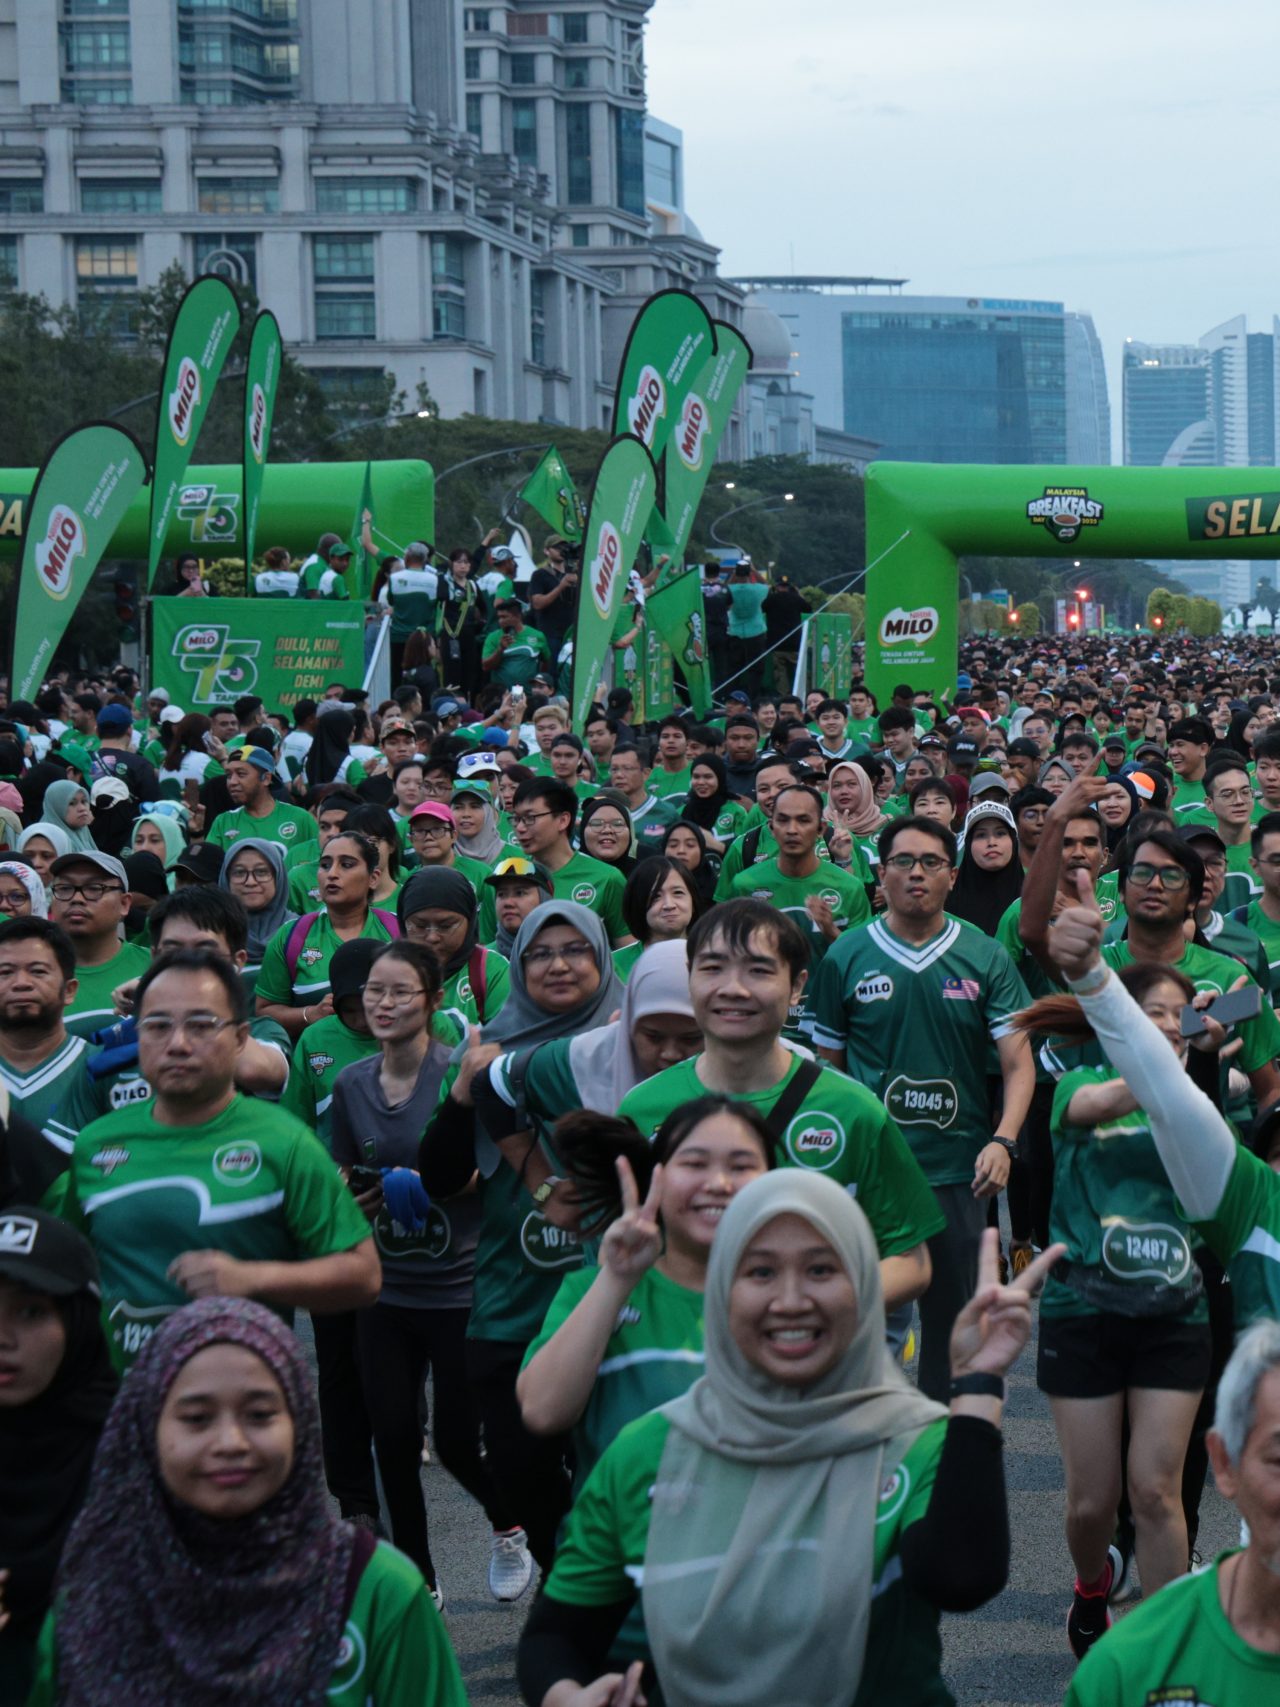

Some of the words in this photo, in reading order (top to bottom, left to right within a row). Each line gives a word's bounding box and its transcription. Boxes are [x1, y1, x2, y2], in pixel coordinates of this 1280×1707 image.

[174, 369, 196, 432] MILO
[634, 378, 660, 441] MILO
[253, 395, 264, 451] MILO
[681, 402, 702, 460] MILO
[1046, 488, 1086, 496] MALAYSIA
[1028, 496, 1102, 518] BREAKFAST
[43, 517, 77, 586] MILO
[596, 535, 617, 605] MILO
[885, 618, 933, 637] MILO
[188, 636, 216, 646] MILO
[274, 655, 345, 669] SELAMANYA
[295, 675, 324, 688] DEMI
[858, 983, 891, 997] MILO
[114, 1087, 148, 1102] MILO
[904, 1090, 943, 1109] 13045
[801, 1135, 834, 1147] MILO
[1126, 1235, 1168, 1260] 12487
